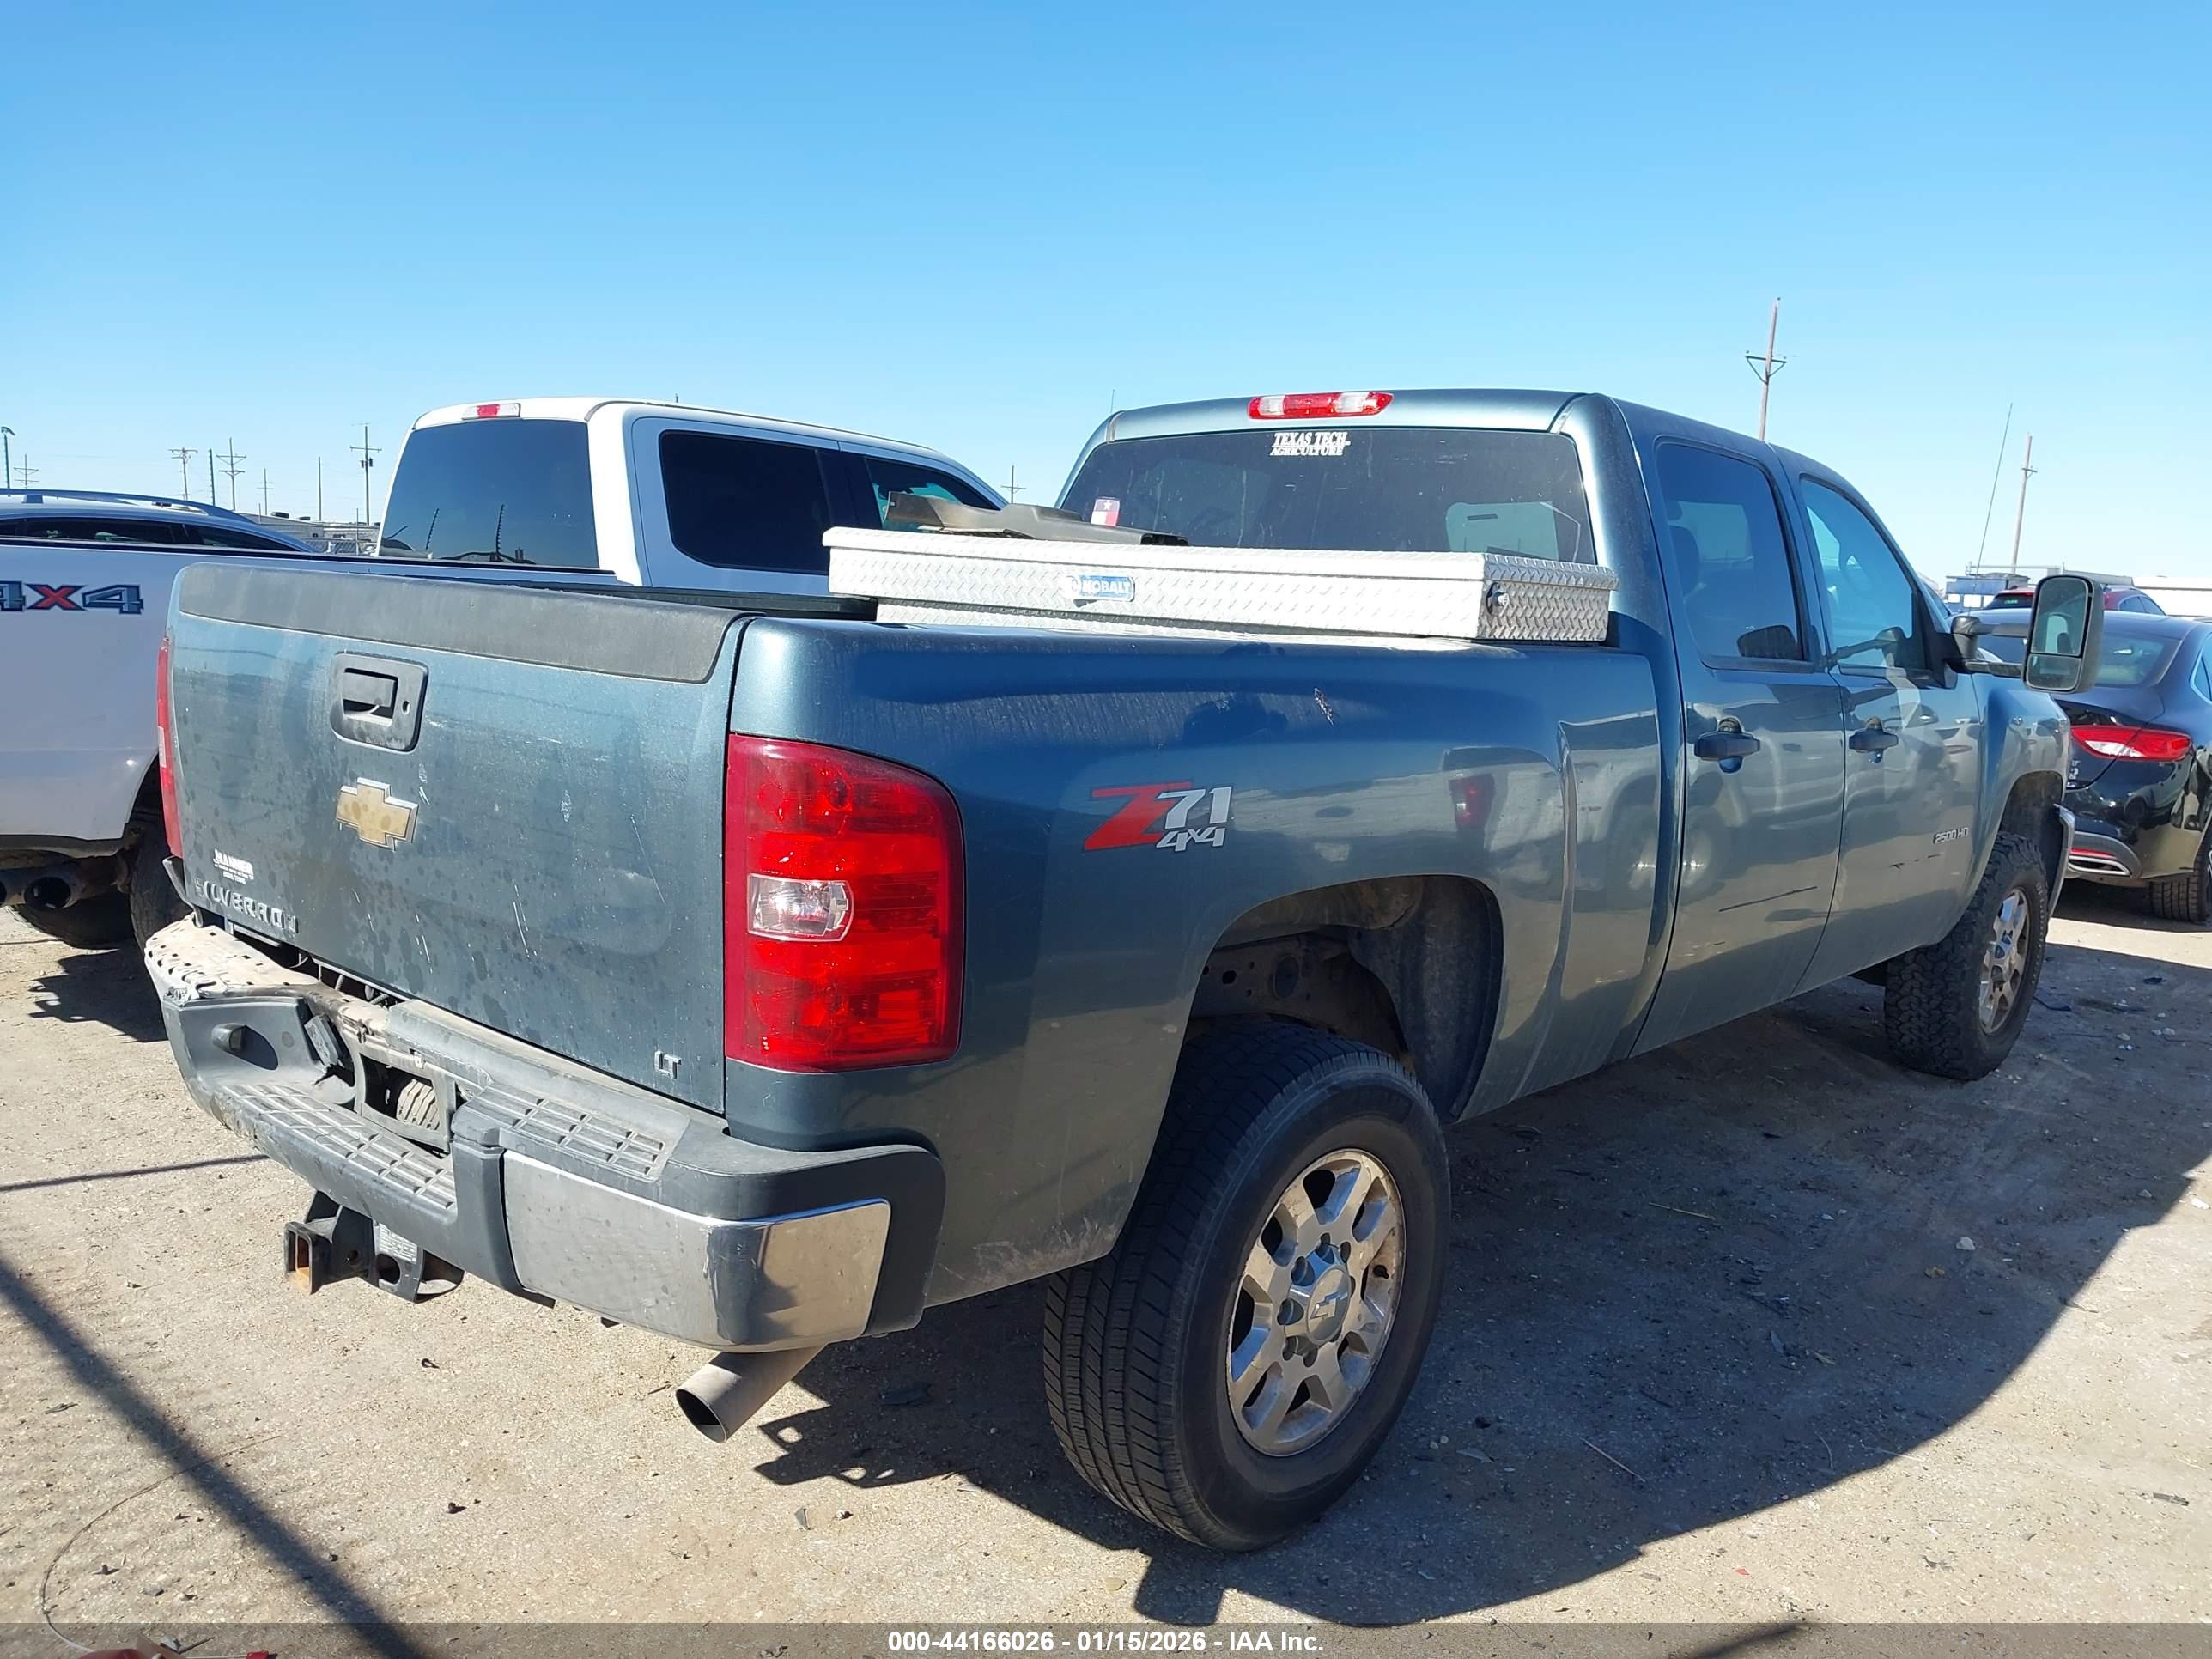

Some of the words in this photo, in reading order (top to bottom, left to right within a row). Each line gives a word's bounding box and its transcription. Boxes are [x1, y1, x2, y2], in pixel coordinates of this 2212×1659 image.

[1273, 432, 1312, 447] TEXAS
[1314, 431, 1348, 447] TECH
[1270, 446, 1345, 456] AGRICULTURE
[1081, 580, 1131, 594] KOBALT
[1085, 780, 1233, 851] Z71
[193, 878, 299, 933] SILVERADO
[654, 1050, 682, 1079] LT
